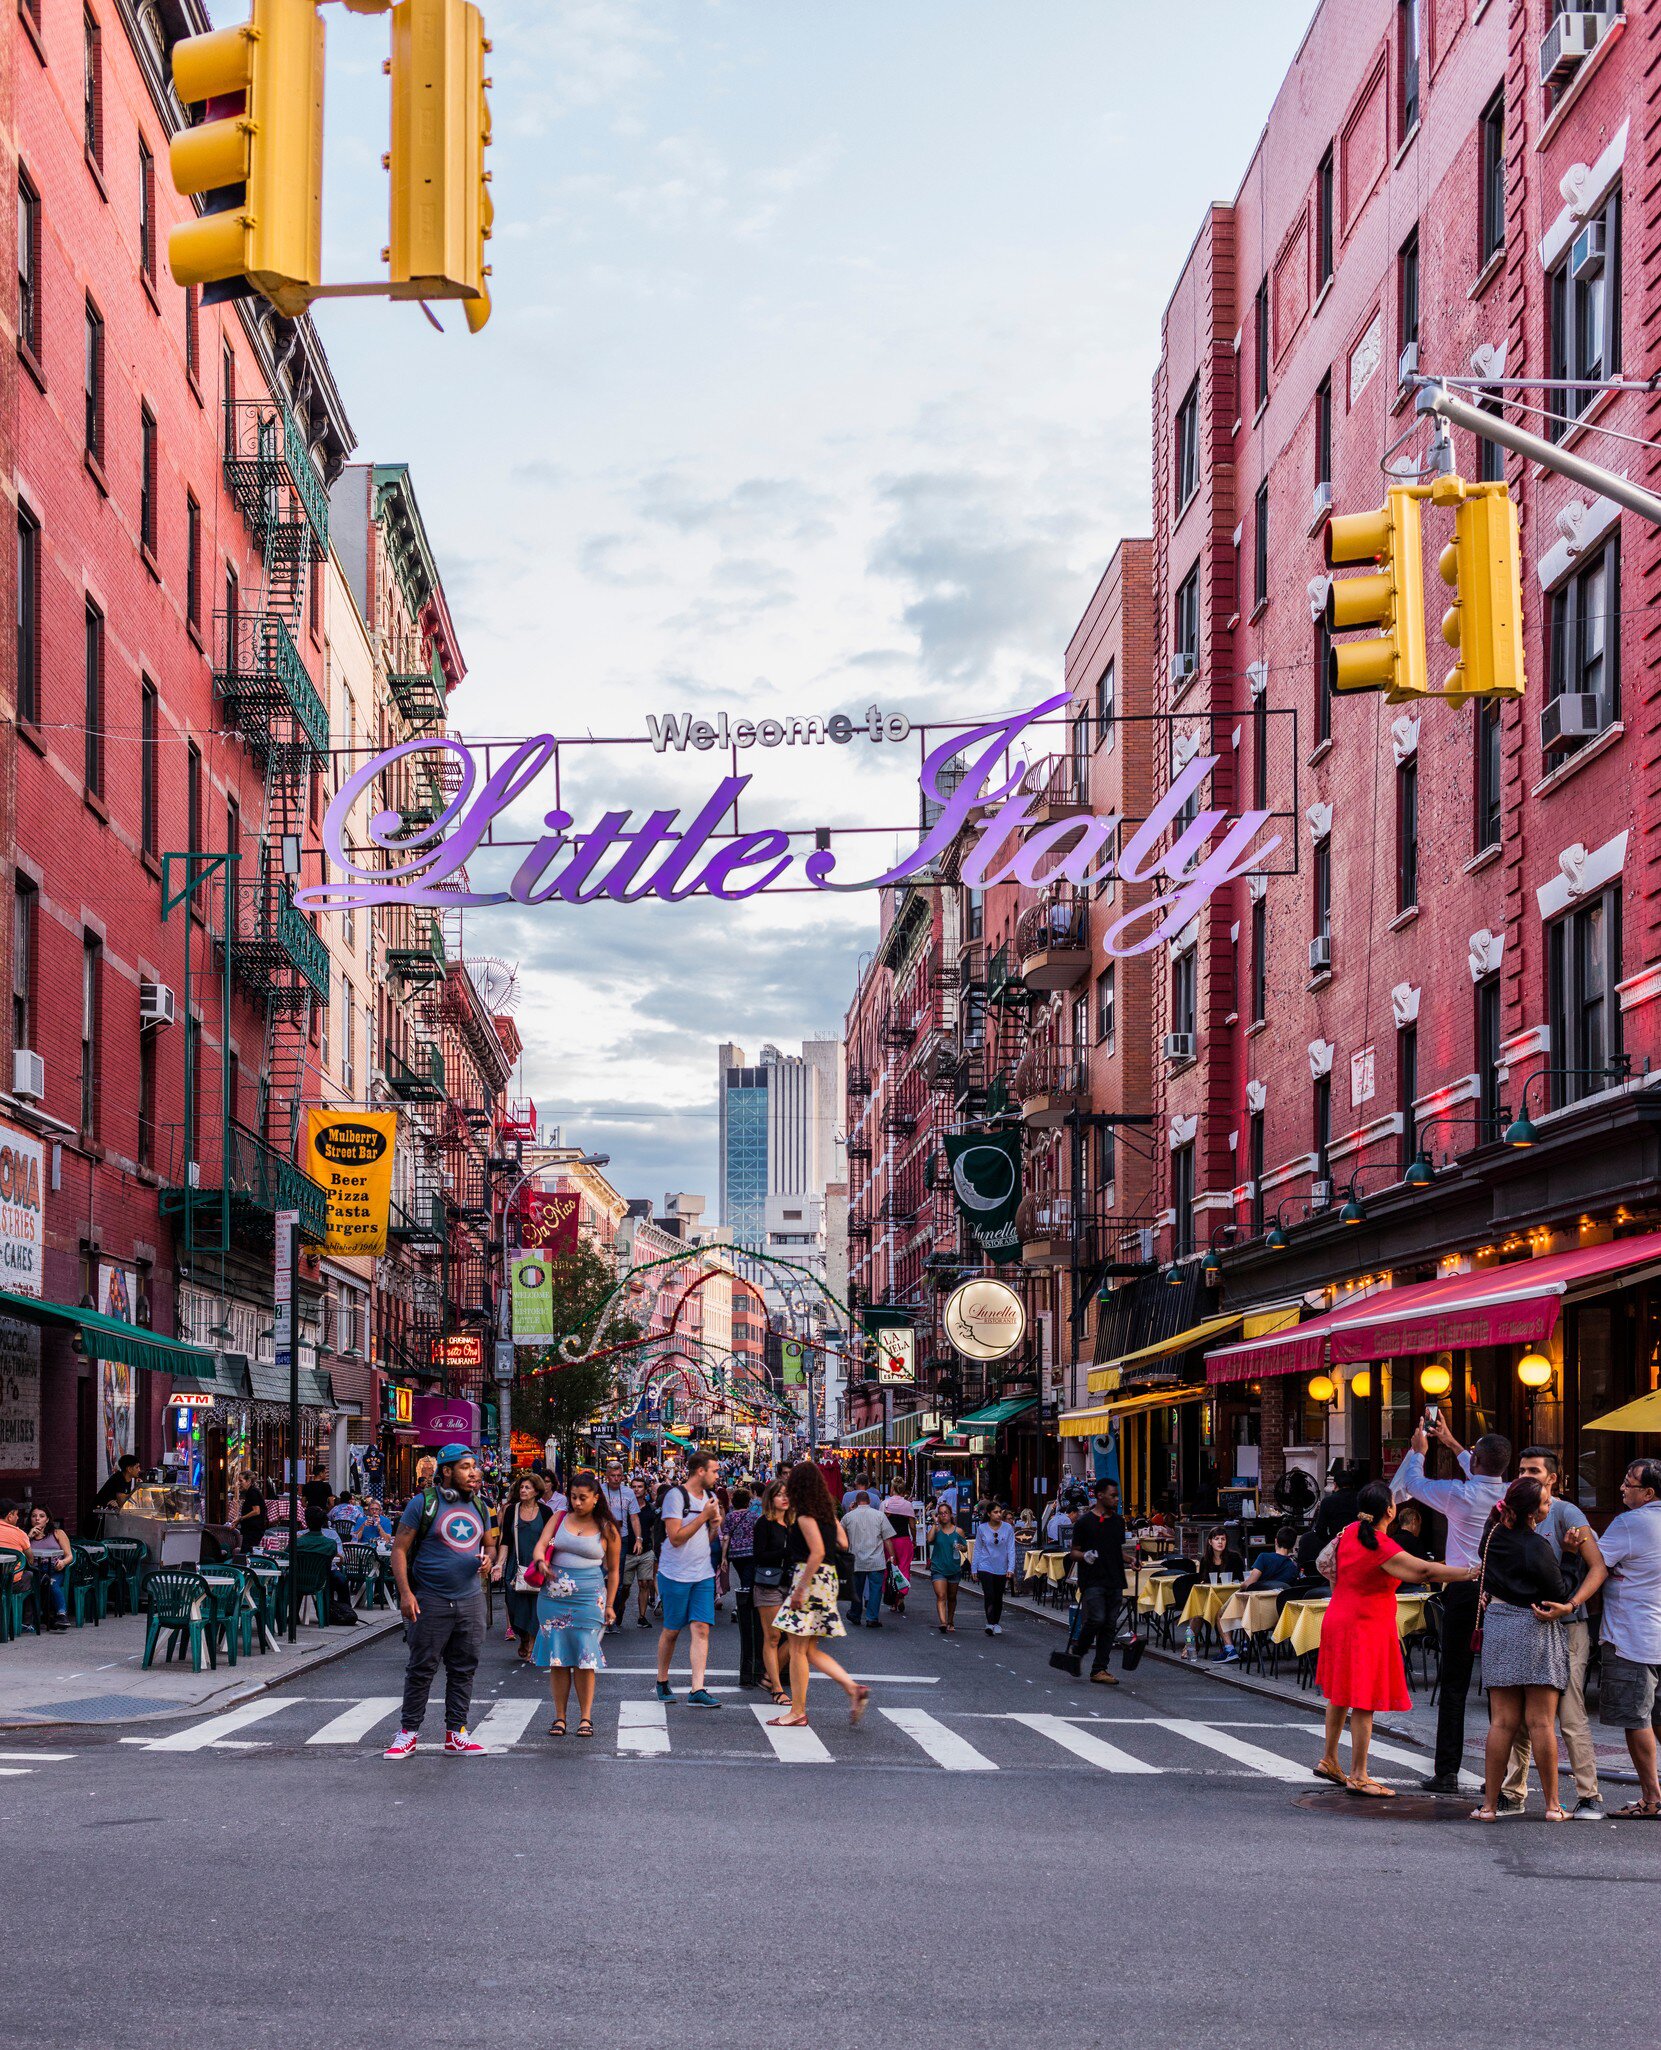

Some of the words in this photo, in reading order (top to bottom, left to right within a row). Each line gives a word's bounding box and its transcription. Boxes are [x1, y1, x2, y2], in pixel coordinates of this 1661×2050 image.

[646, 711, 854, 753] Welcome
[865, 703, 911, 743] to
[294, 732, 793, 909] Little
[807, 691, 1282, 957] Italy
[328, 1129, 379, 1146] Mulberry
[324, 1144, 357, 1159] Street
[358, 1147, 379, 1160] Bar
[0, 1145, 40, 1213] OMA
[331, 1173, 367, 1186] Beer
[326, 1189, 370, 1202] Pizza
[325, 1204, 371, 1218] Pasta
[0, 1203, 35, 1241] STRIES
[326, 1222, 379, 1236] urgers
[521, 1223, 550, 1249] Da
[543, 1197, 577, 1229] Nico
[4, 1242, 33, 1272] CAKES
[968, 1303, 1017, 1321] Lunella
[883, 1332, 900, 1346] LA
[1437, 1318, 1489, 1347] Ristorante
[448, 1336, 476, 1345] ORIGINAL
[172, 1395, 209, 1404] ATM
[433, 1417, 444, 1429] La
[446, 1418, 465, 1429] Bella
[592, 1425, 615, 1433] DANTE
[962, 1487, 969, 1496] P
